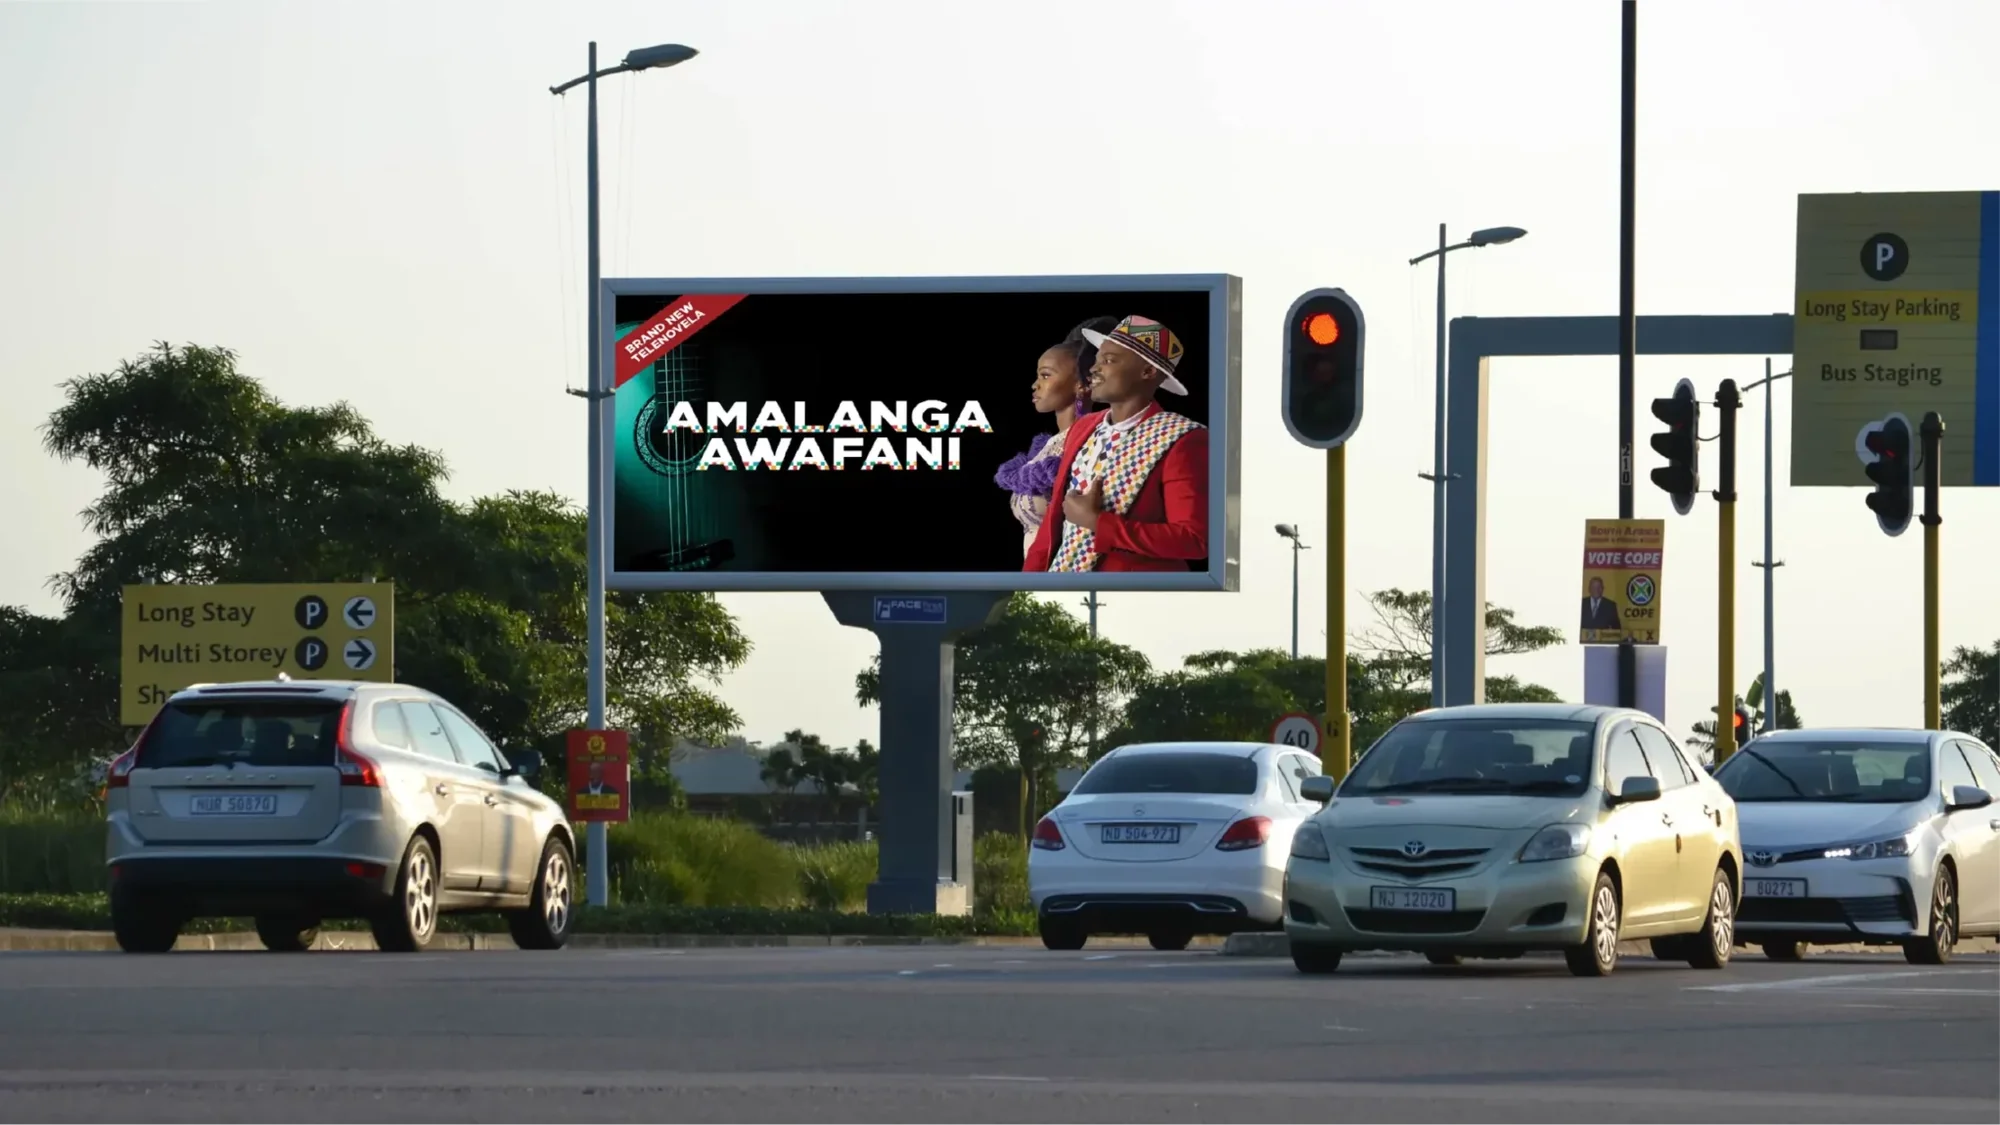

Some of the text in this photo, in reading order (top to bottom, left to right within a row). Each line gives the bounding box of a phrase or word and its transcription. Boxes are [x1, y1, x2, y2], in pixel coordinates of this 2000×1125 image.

[1876, 243, 1894, 271] P
[1805, 298, 1960, 321] Long Stay Parking
[624, 301, 694, 354] BRAND NEW
[630, 310, 706, 362] TELENOVELA
[1820, 363, 1942, 386] Bus Staging
[663, 399, 994, 433] AMALANGA
[695, 437, 961, 470] AWAFANI
[1588, 551, 1661, 565] VOTE COPE
[138, 601, 320, 627] Long Stay P
[891, 600, 921, 609] FACE
[1623, 607, 1655, 619] COPE
[138, 642, 320, 668] Multi Storey P
[1282, 729, 1310, 748] 40
[1105, 827, 1175, 840] ND 504-971
[1379, 891, 1446, 908] NJ 12020
[1757, 882, 1794, 895] 80271
